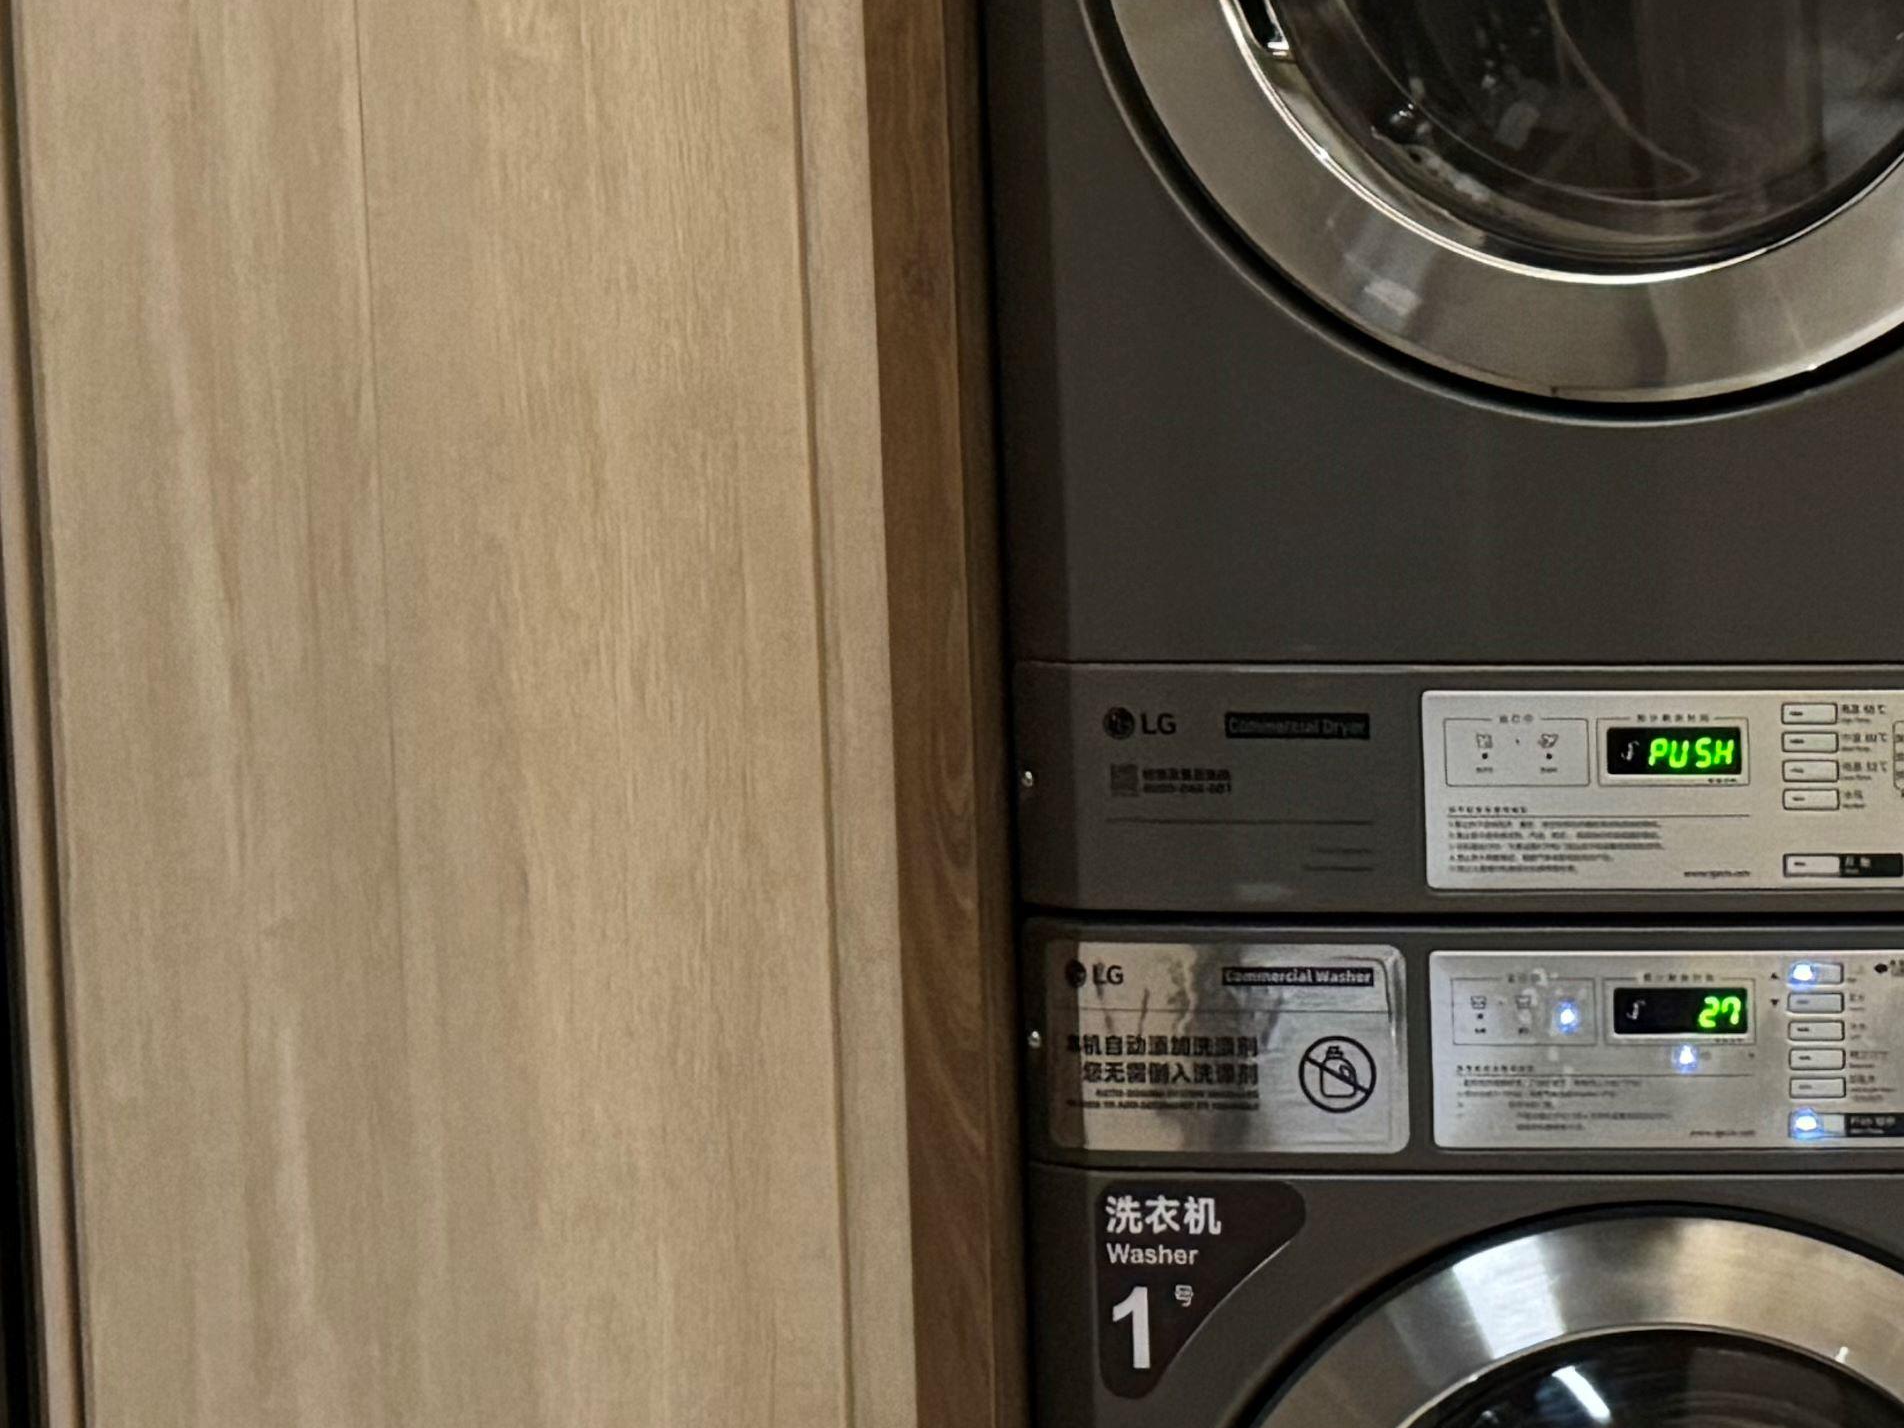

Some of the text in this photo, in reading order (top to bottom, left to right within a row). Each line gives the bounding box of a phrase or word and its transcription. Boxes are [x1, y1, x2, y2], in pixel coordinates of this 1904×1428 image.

[1141, 712, 1177, 735] LG
[1649, 737, 1734, 768] PUSH
[1092, 965, 1123, 985] LG
[1315, 968, 1372, 985] Washer
[1699, 996, 1741, 1028] 27
[1105, 1195, 1222, 1235] 洗衣机
[1106, 1243, 1199, 1264] Washer
[1112, 1284, 1194, 1369] 1 号
